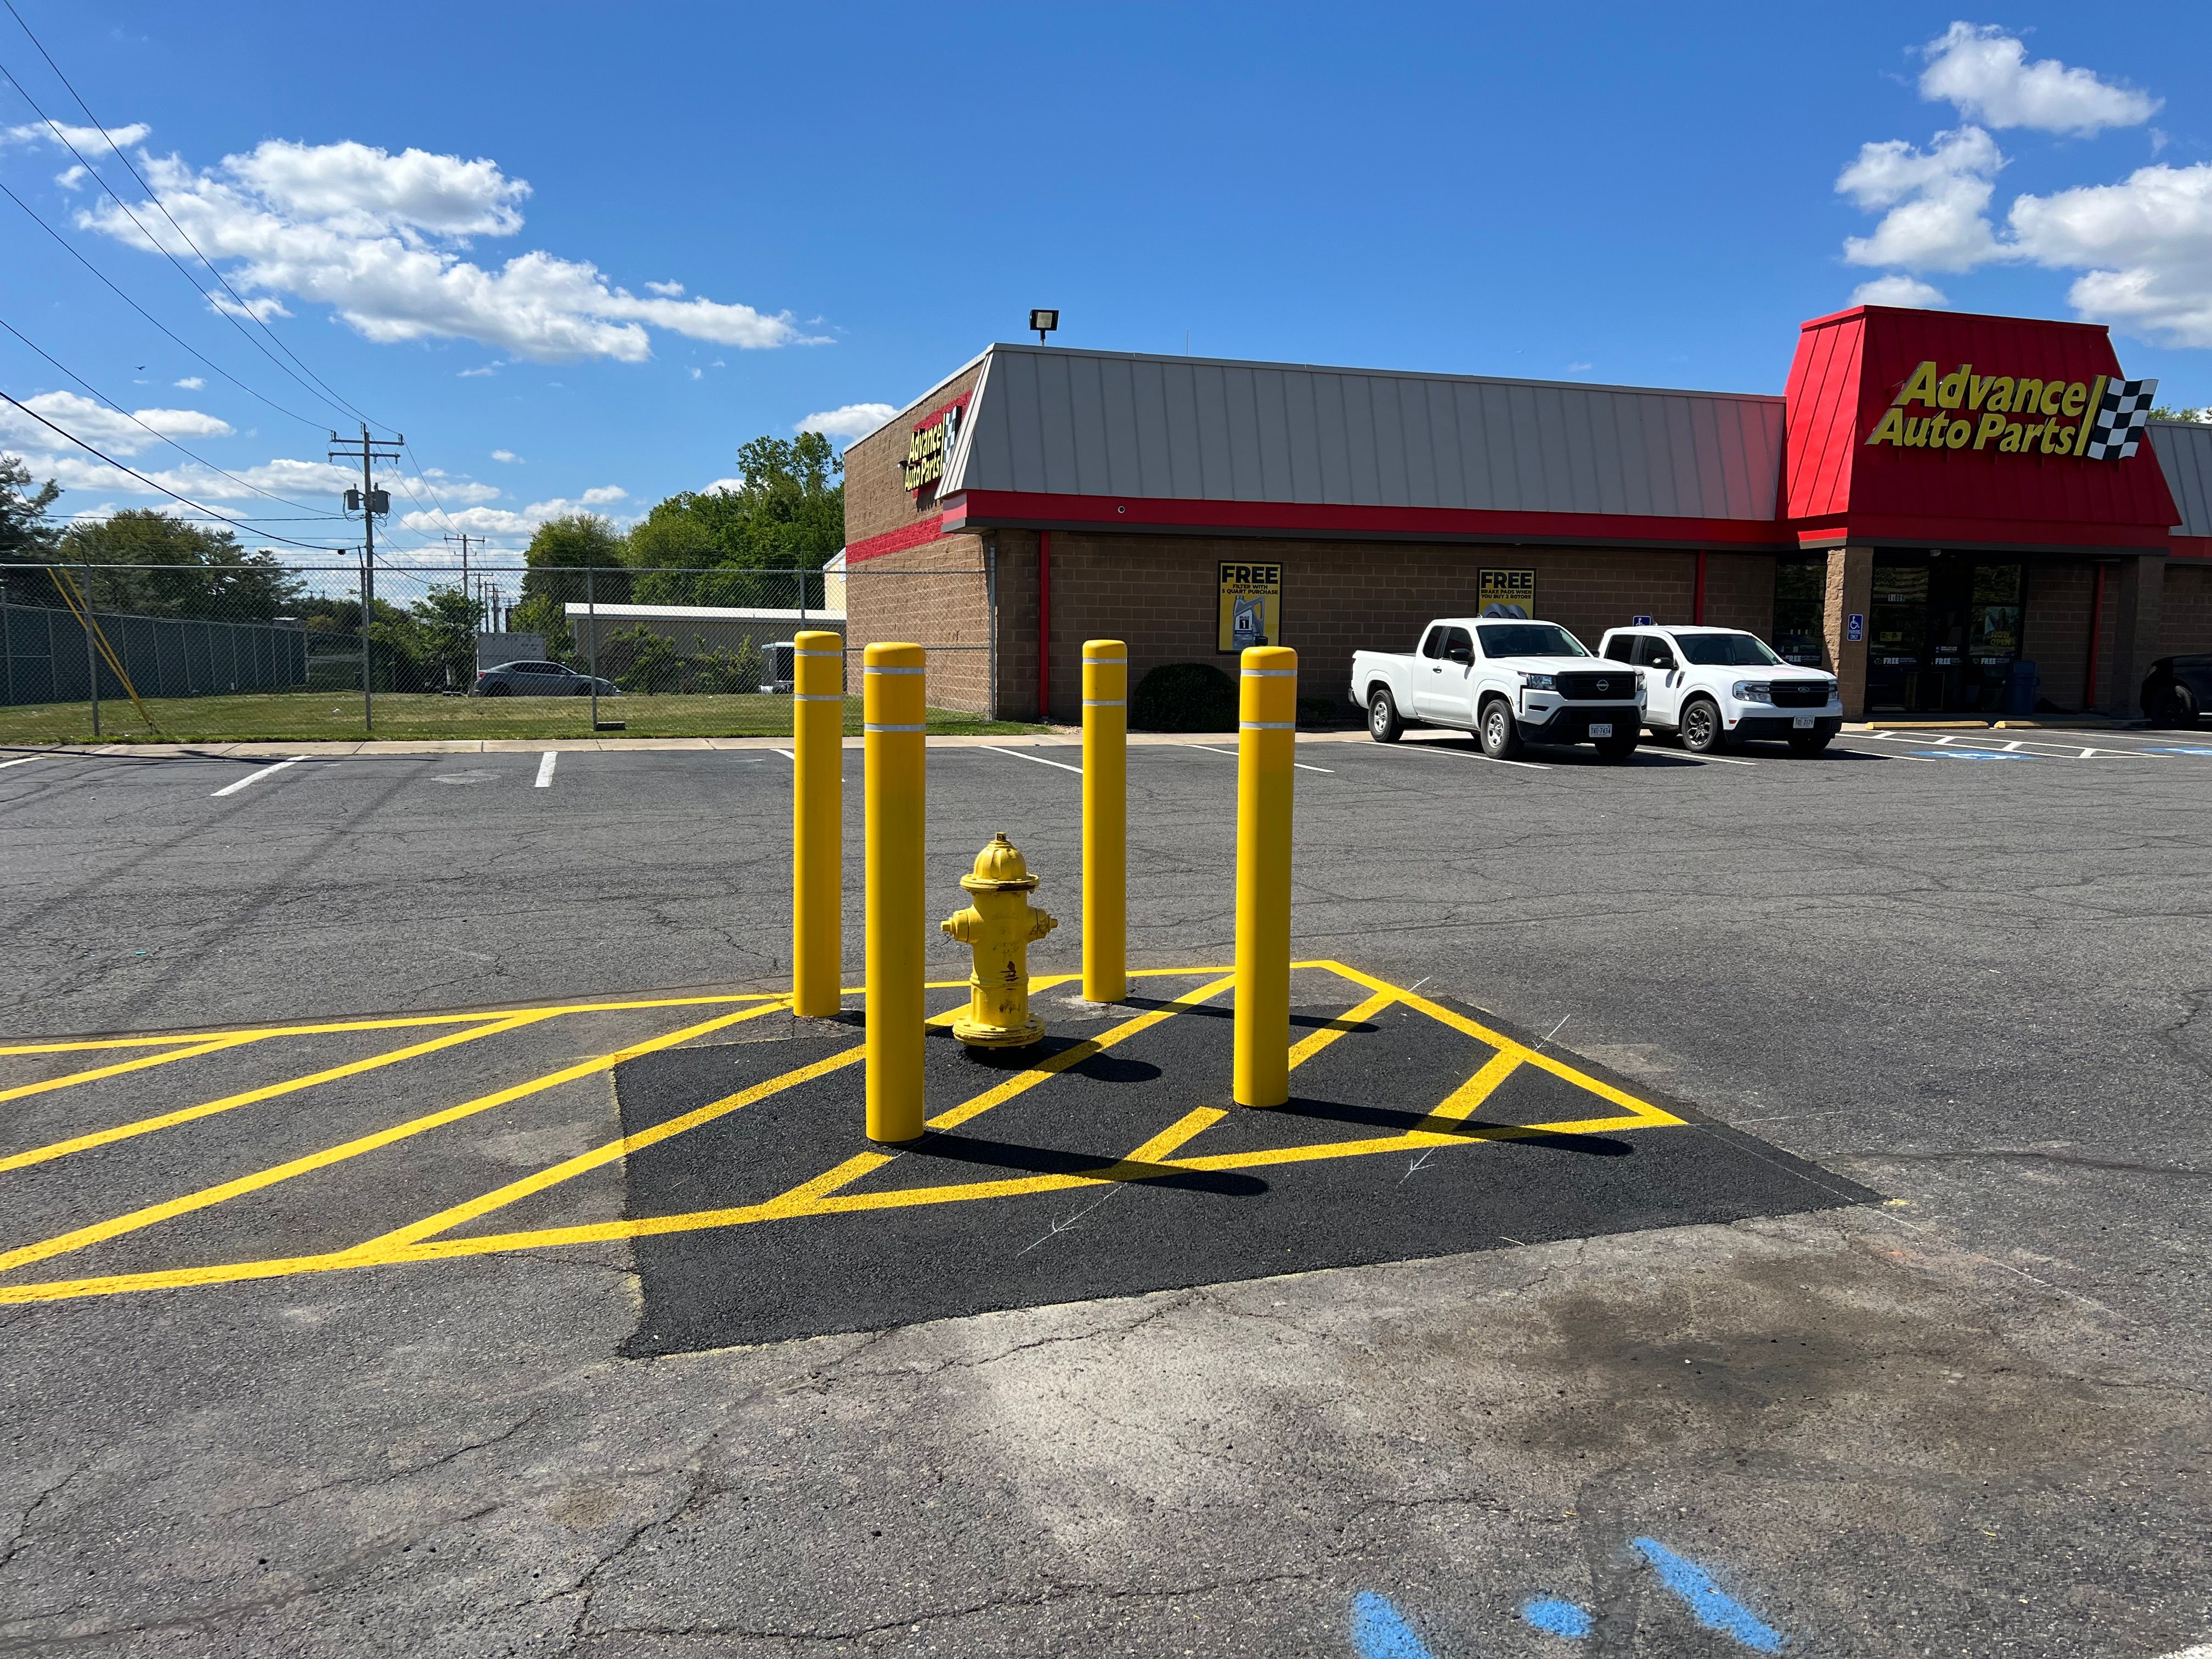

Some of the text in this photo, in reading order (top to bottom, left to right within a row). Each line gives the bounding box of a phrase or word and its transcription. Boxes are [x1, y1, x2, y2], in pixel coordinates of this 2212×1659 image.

[1891, 360, 2087, 417] Advance
[907, 422, 942, 465] Advance
[1864, 408, 2075, 455] Auto Parts
[904, 452, 940, 492] Auto Parts
[1222, 565, 1278, 584] FREE
[1481, 572, 1532, 589] FREE
